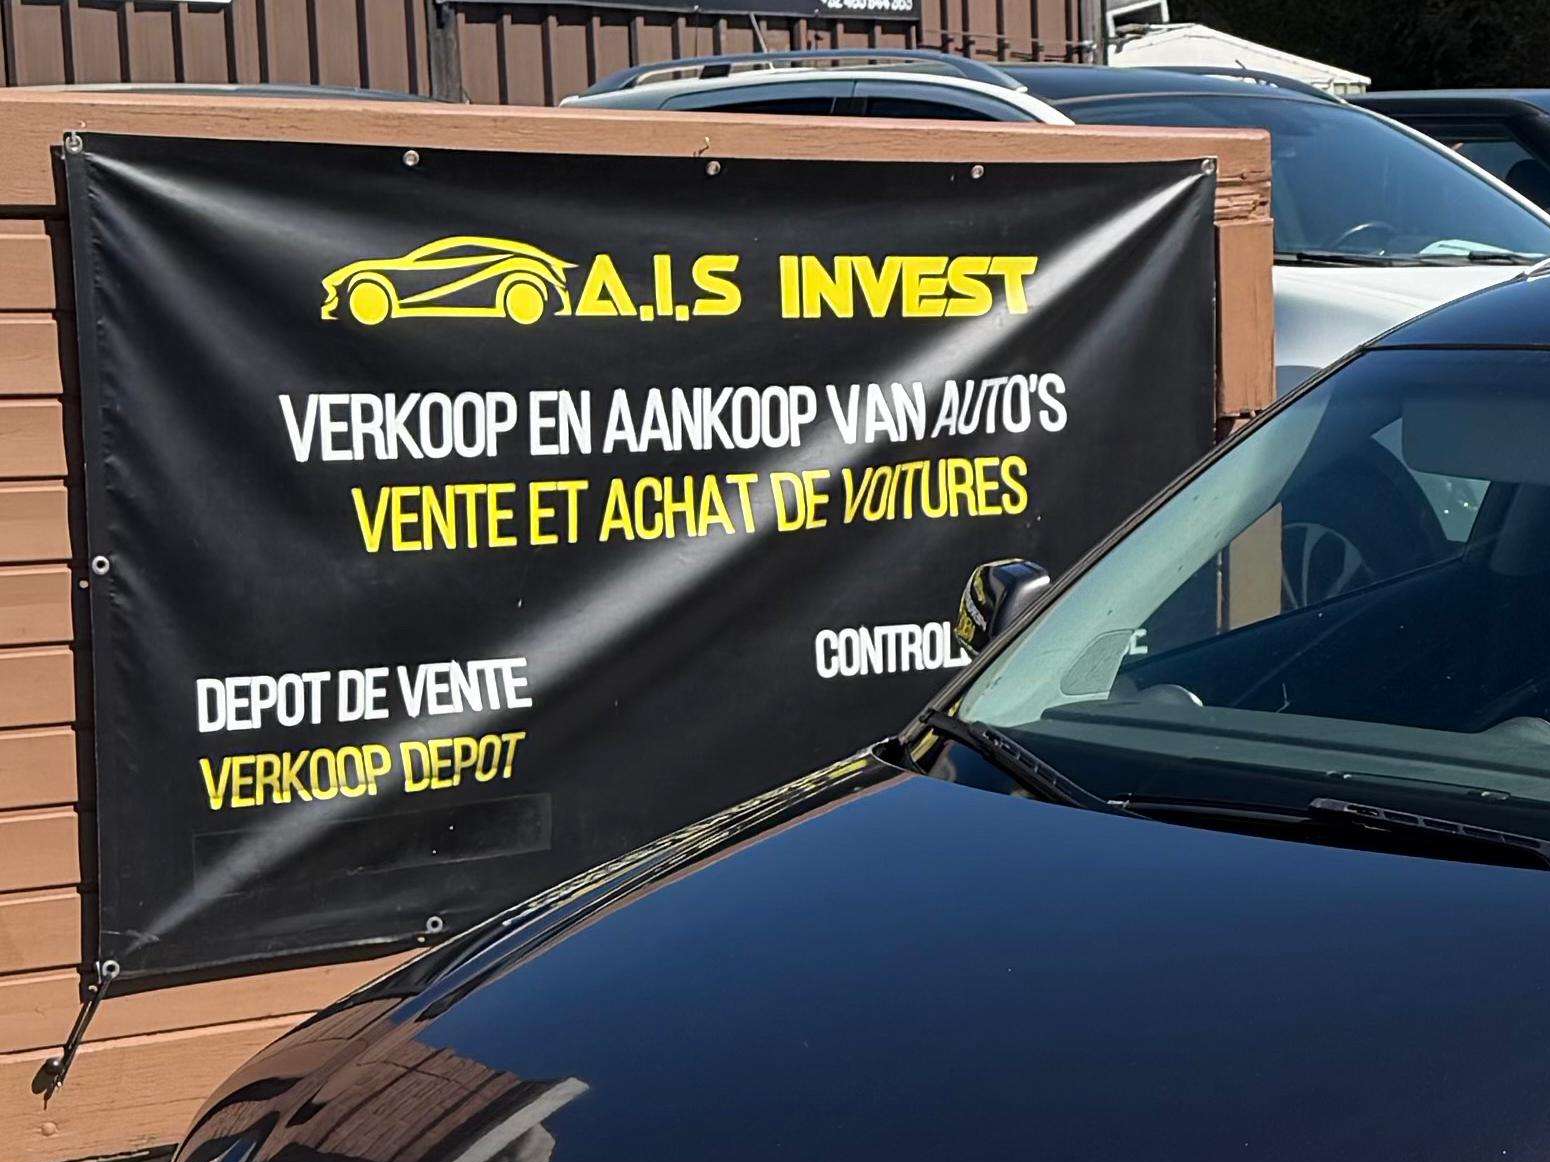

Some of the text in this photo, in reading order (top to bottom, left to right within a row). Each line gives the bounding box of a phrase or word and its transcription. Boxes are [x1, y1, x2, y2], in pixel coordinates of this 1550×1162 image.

[576, 253, 1039, 322] A.I.S INVEST
[279, 372, 1068, 463] VERKOOP EN AANKOOP VAN AUTO'S
[351, 455, 1029, 553] VENTE ET ACHAT DE VOITURES
[815, 621, 973, 679] CONTROL
[196, 657, 533, 733] DEPOT DE VENTE
[199, 731, 527, 811] VERKOOP DEPOT
